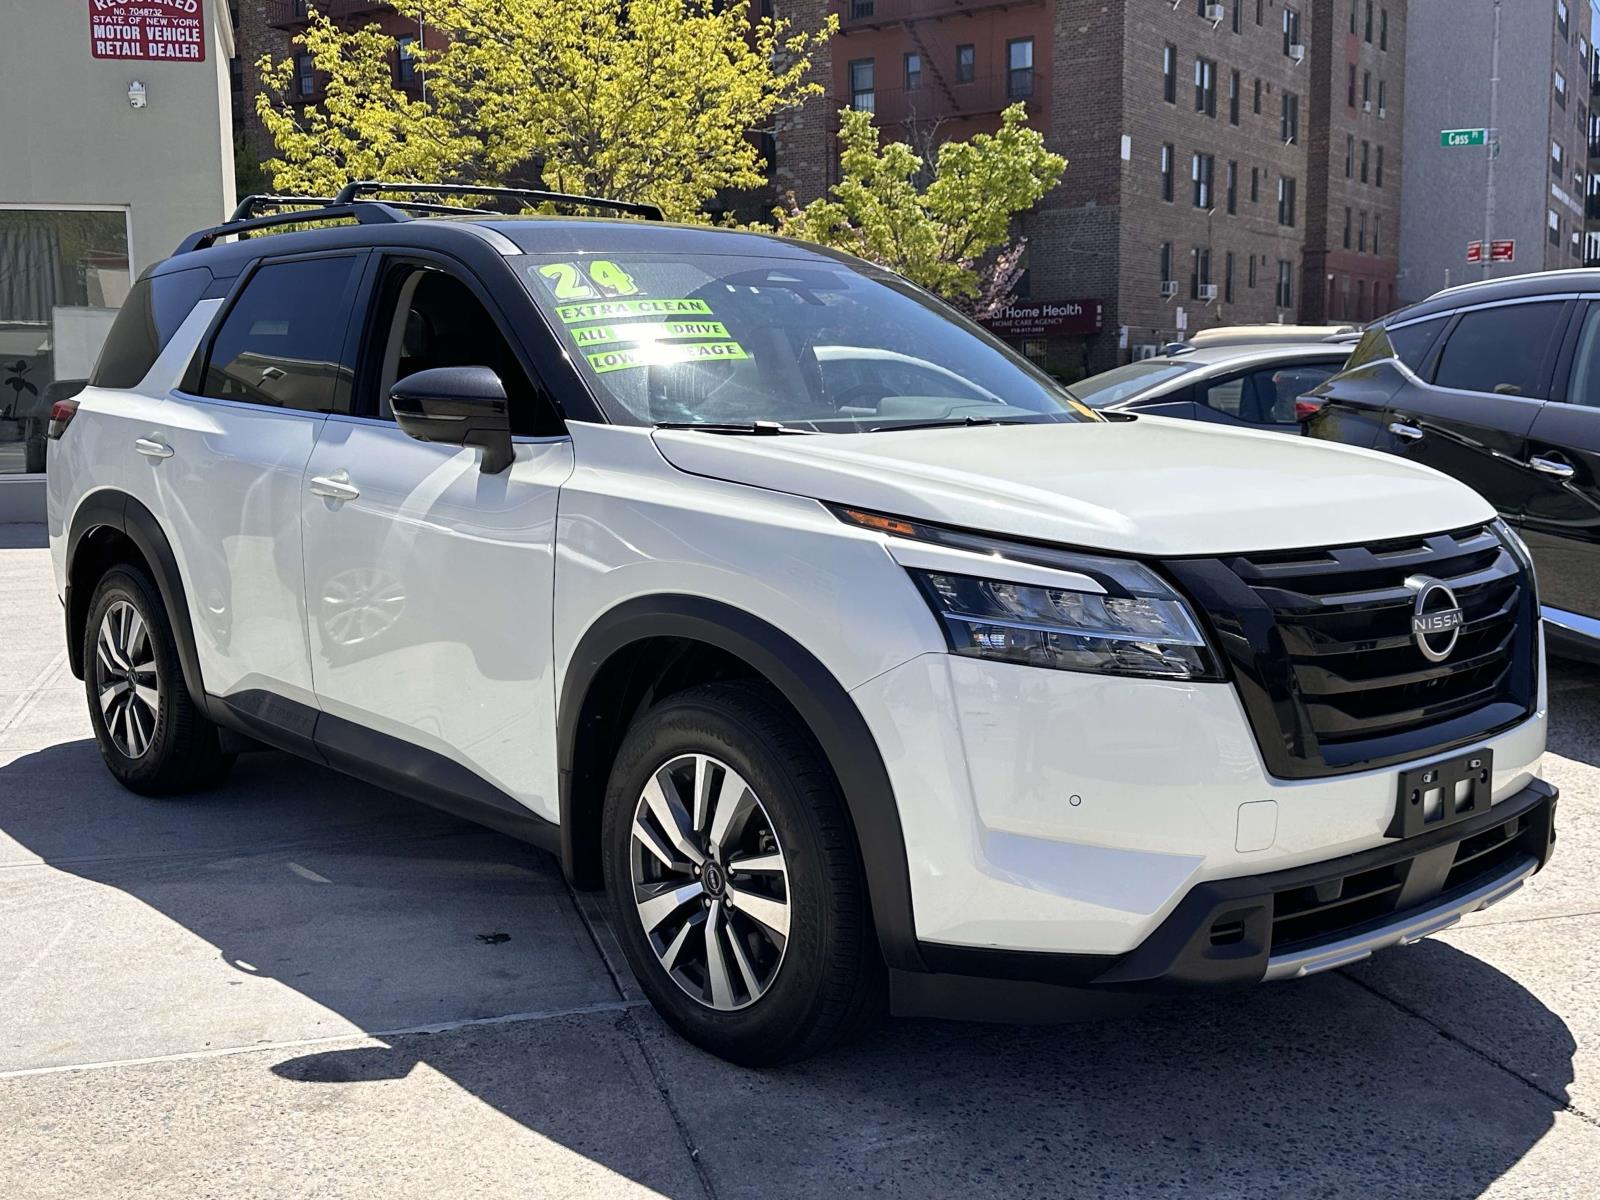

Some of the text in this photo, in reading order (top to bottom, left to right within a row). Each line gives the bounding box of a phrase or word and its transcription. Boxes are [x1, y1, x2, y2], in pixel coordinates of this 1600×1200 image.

[113, 7, 163, 16] NO. 7048732
[93, 15, 200, 27] STATE OF NEW YORK
[94, 25, 201, 42] MOTOR VEHICLE
[96, 41, 199, 58] RETAIL DEALER
[1448, 133, 1469, 145] Cass
[538, 260, 640, 299] 24
[562, 300, 704, 319] EXTRA CLEAN
[1006, 304, 1040, 318] Home
[1043, 303, 1082, 316] Health
[992, 318, 1063, 327] HOME CARE AGENCY
[577, 328, 608, 341] ALL
[673, 323, 723, 335] DRIVE
[1414, 612, 1463, 631] NISSAN
